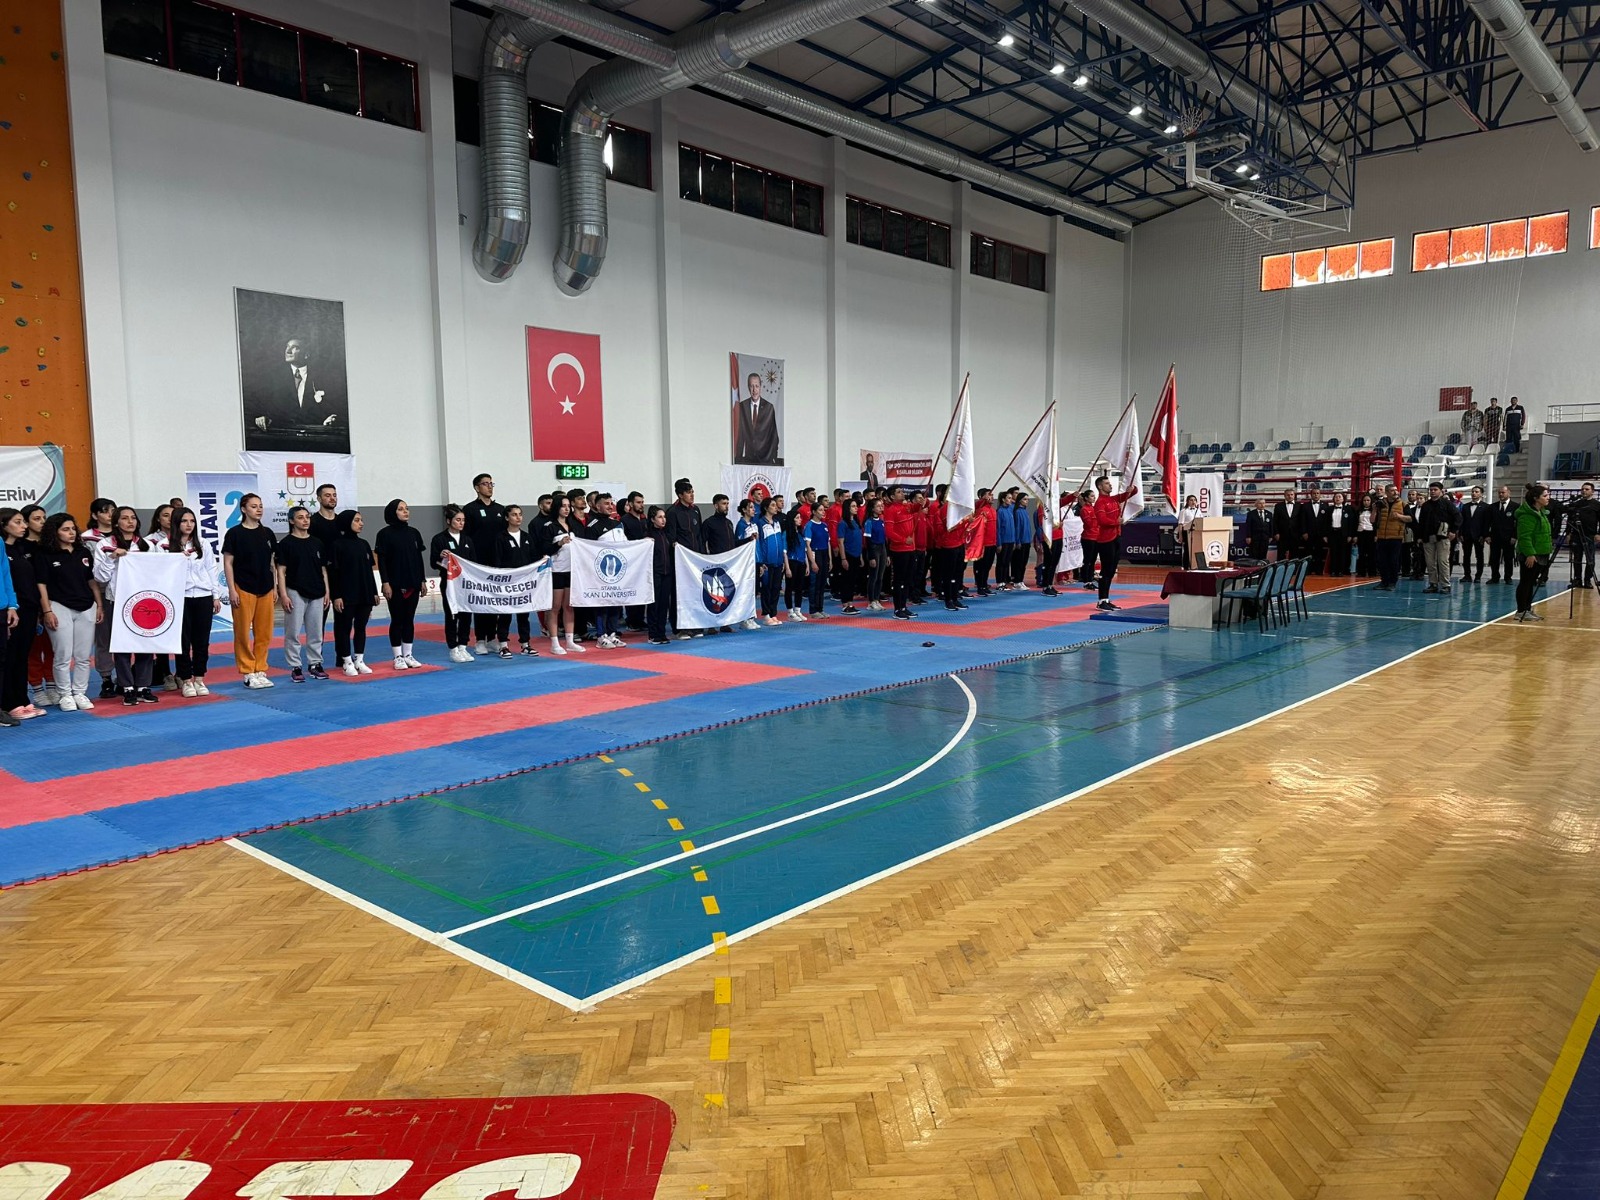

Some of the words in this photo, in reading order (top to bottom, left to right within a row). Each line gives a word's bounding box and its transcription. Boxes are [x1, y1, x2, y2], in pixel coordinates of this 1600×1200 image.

[563, 466, 587, 477] 15:33
[199, 492, 220, 563] ATAMI
[505, 580, 537, 593] ÇEÇEN
